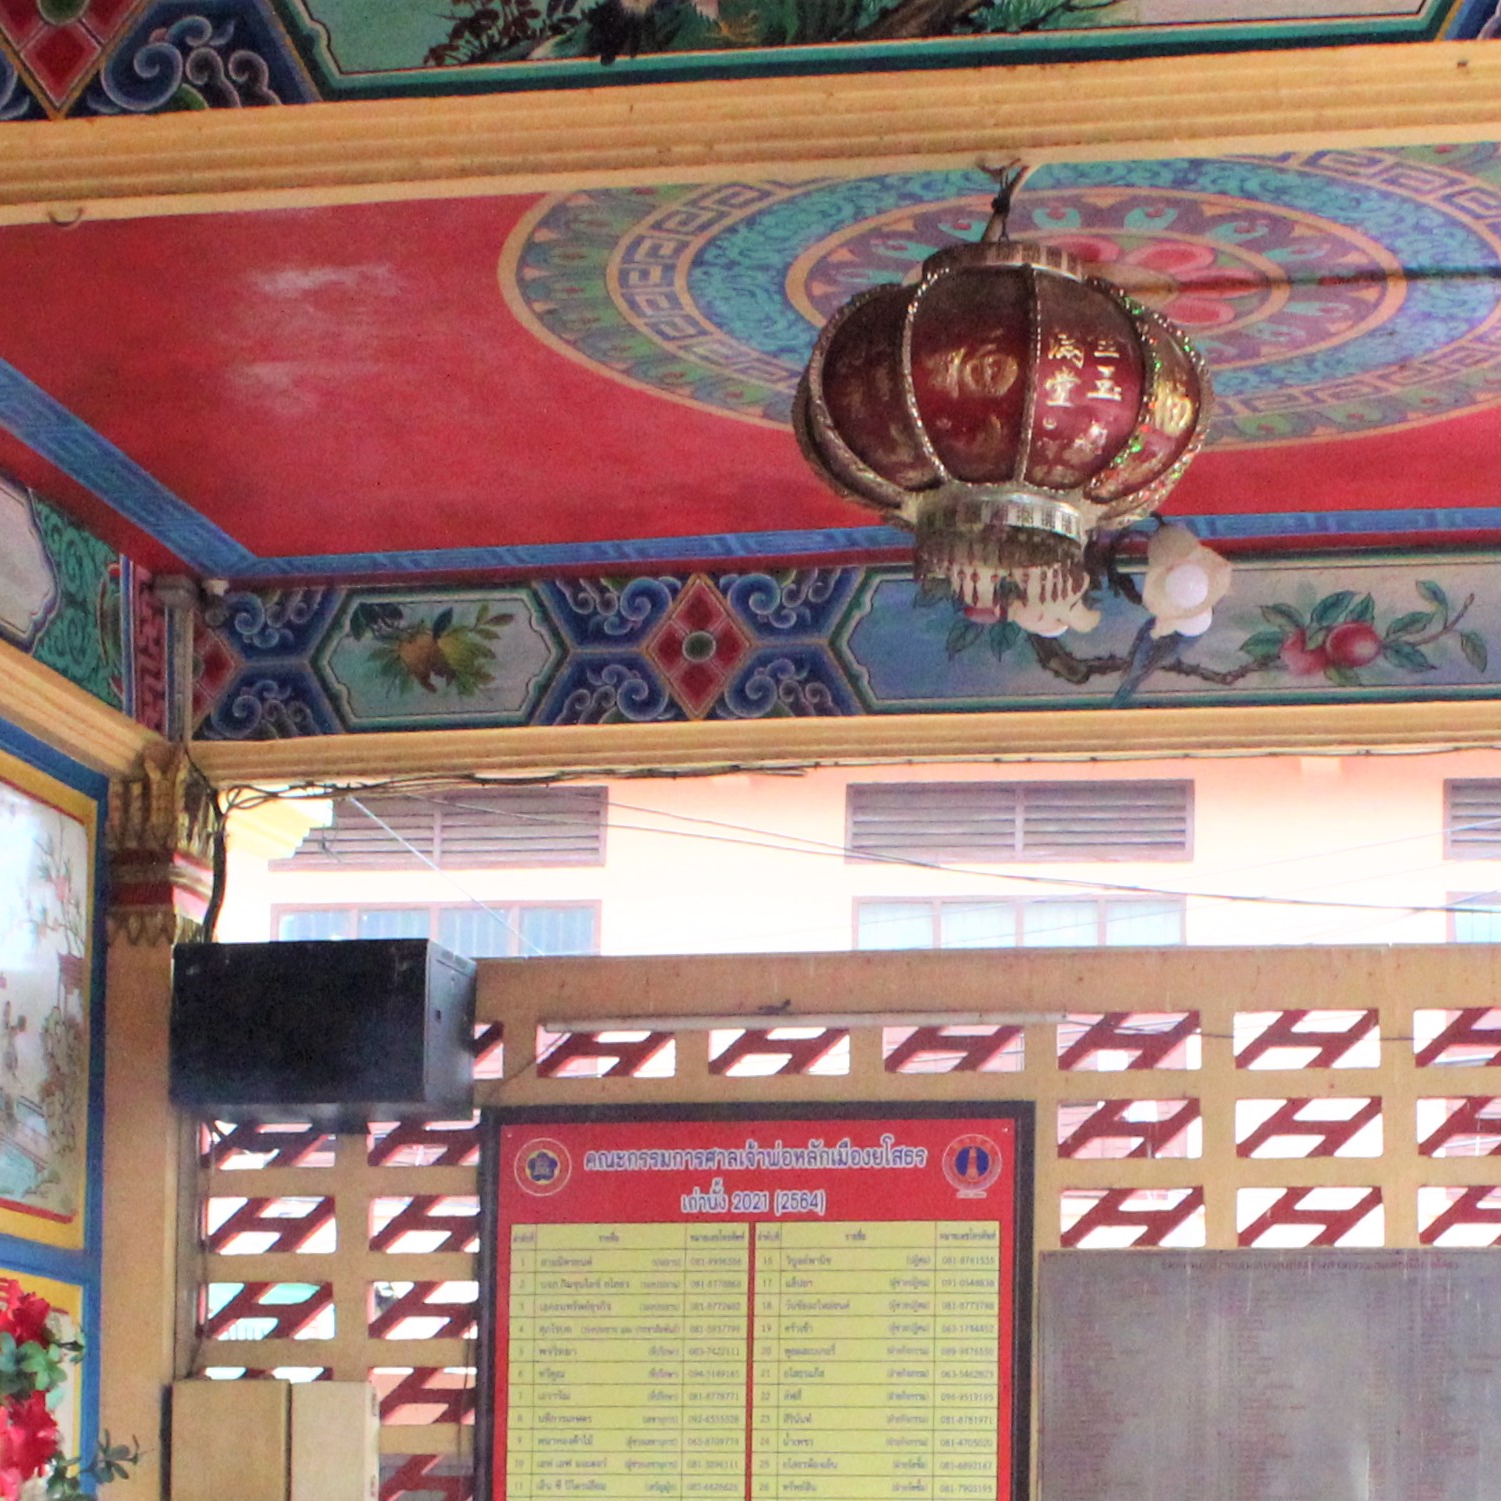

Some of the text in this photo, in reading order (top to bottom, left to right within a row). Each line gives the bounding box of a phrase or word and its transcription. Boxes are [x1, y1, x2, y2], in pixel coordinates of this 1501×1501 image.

[584, 1134, 927, 1171] คณะกรรมการศาลเจ้าพ่อหลักเมืองยโสธร
[731, 1190, 770, 1212] 2021
[773, 1189, 827, 1216] (2564)
[763, 1279, 771, 1287] 17
